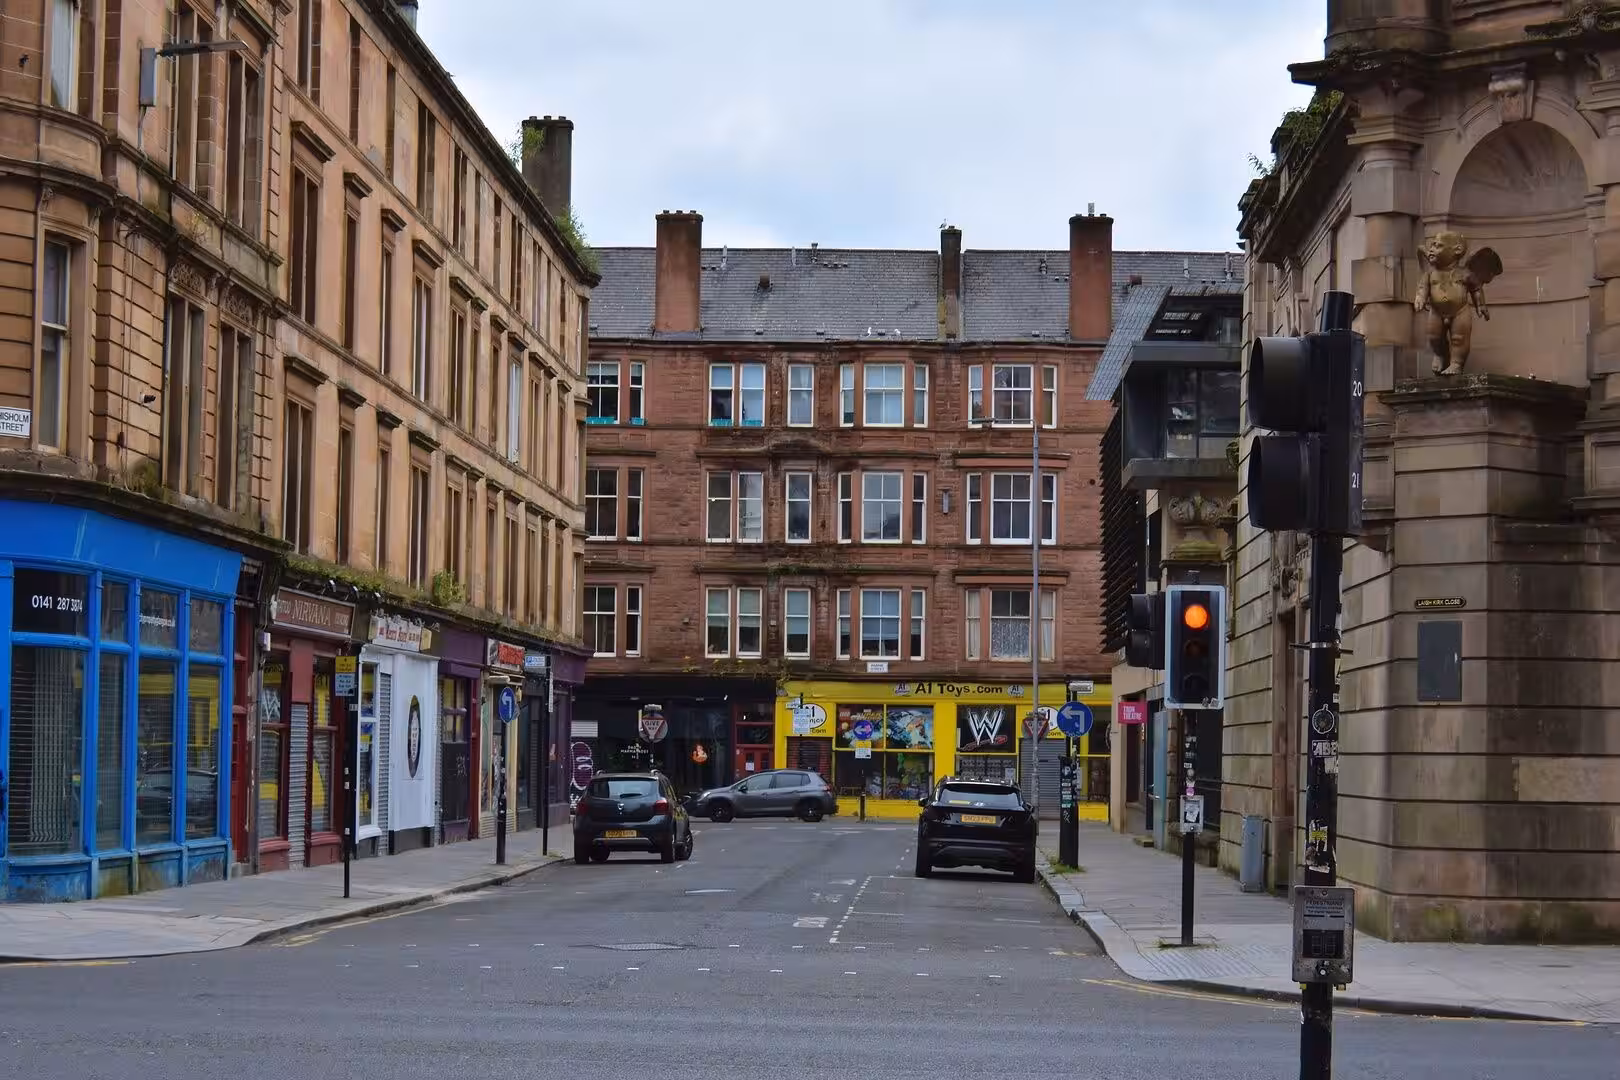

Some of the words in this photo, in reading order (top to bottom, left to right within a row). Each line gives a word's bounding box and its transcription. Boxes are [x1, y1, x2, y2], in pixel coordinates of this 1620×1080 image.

[1352, 380, 1362, 396] 20
[0, 421, 24, 432] TREET
[1351, 472, 1360, 488] 21
[31, 594, 53, 609] 0141
[57, 597, 70, 611] 287
[292, 600, 331, 626] NIRVANA
[915, 682, 933, 695] A1
